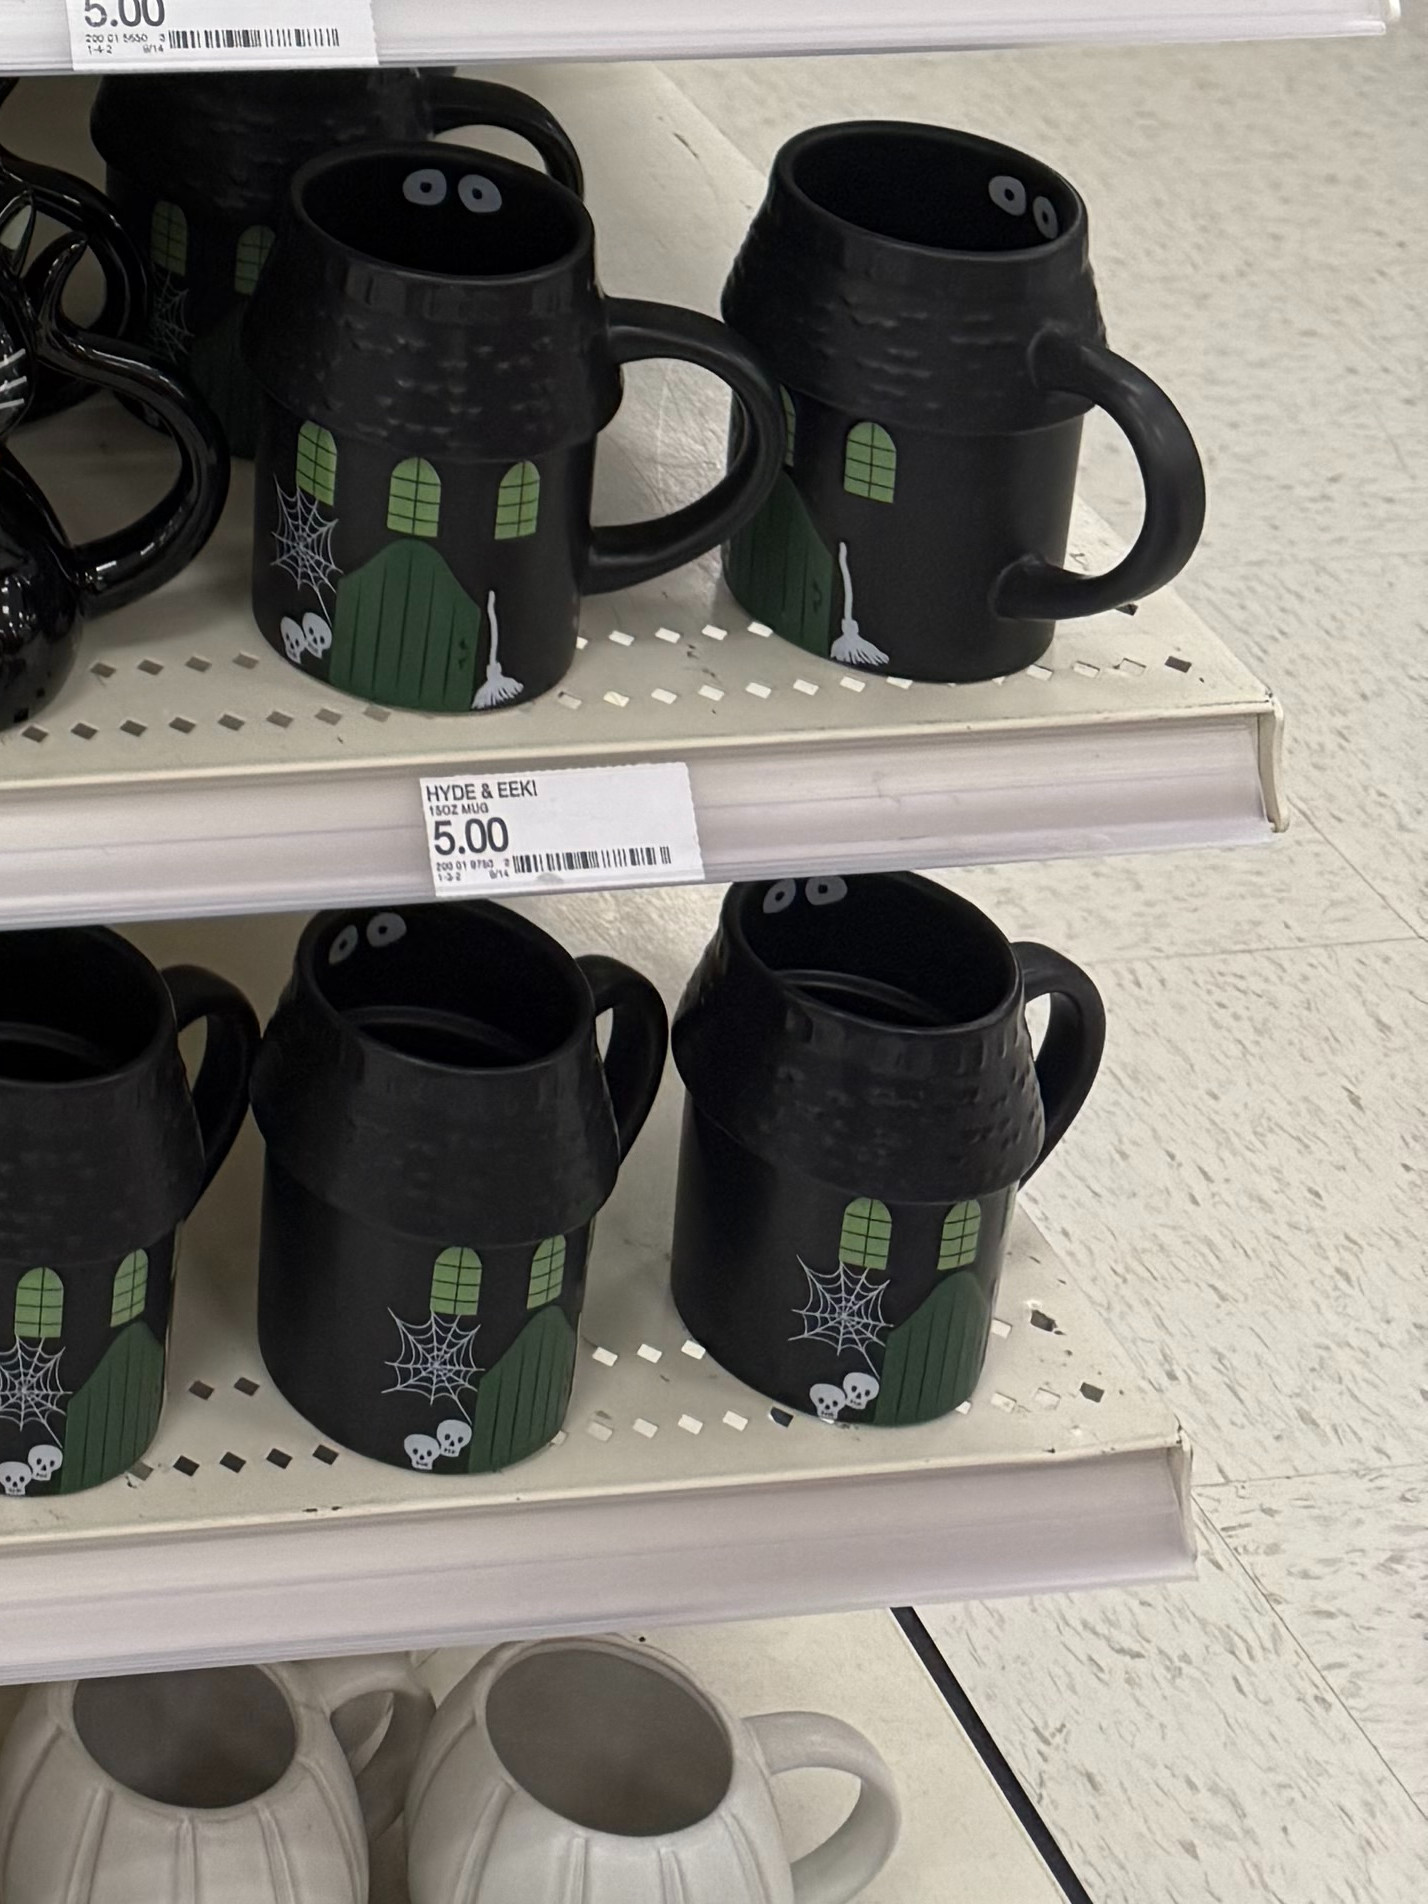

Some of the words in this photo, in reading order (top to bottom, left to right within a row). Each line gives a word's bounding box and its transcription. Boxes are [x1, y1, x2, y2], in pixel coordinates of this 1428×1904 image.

[426, 783, 477, 802] HYDE
[482, 783, 494, 799] &
[462, 802, 489, 814] MUG
[434, 817, 509, 856] 5.00
